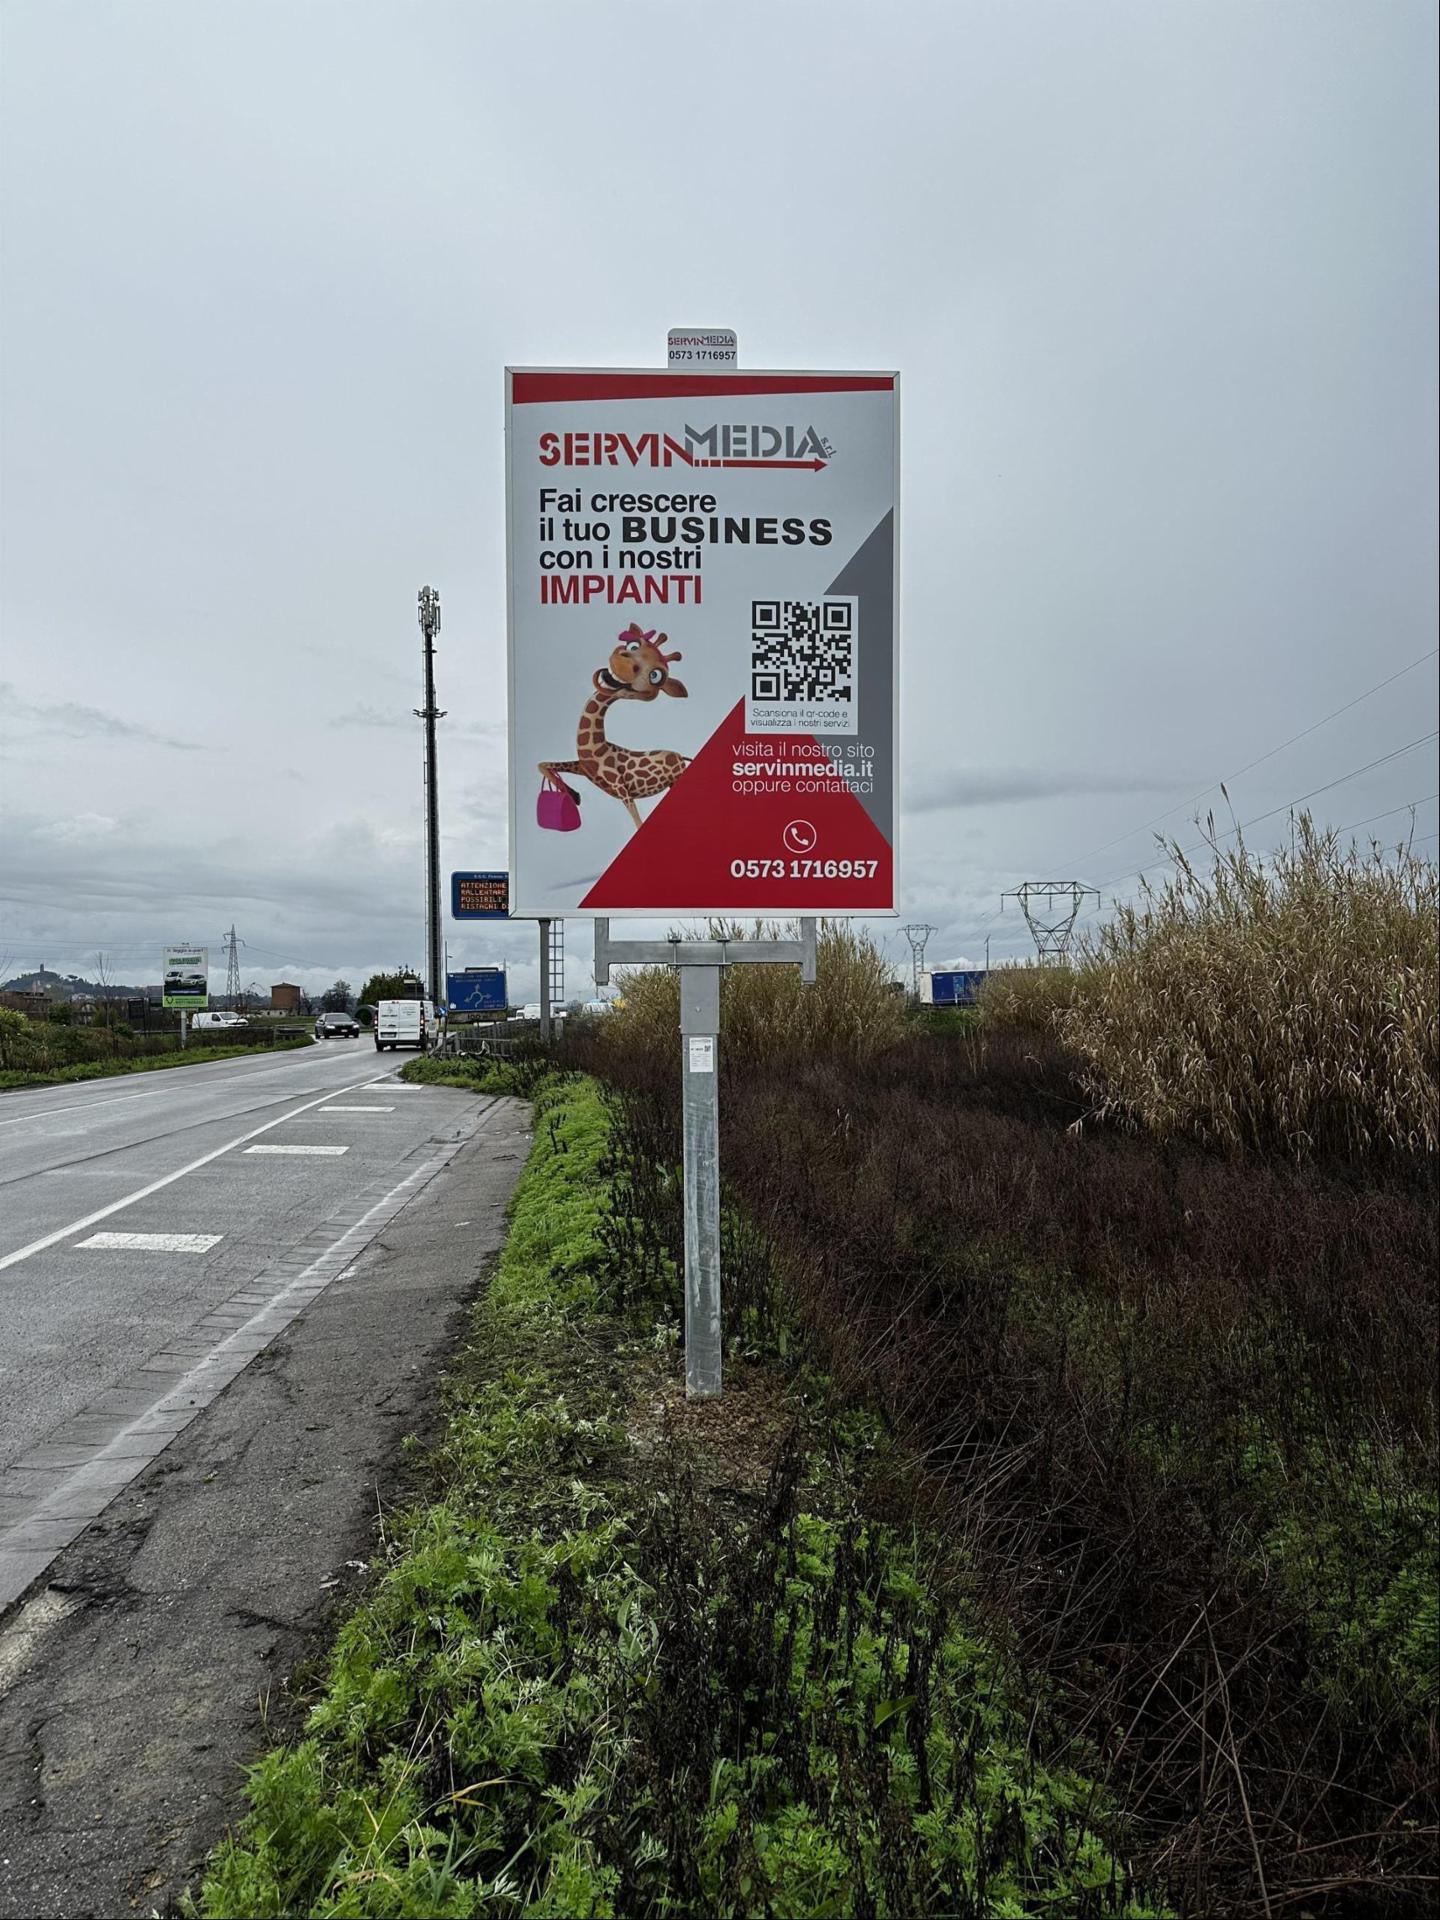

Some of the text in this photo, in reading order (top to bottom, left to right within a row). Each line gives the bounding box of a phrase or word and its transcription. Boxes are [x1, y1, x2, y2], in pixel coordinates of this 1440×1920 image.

[668, 335, 735, 346] SERVINMEDIA
[669, 350, 737, 360] 0573 1716957
[539, 488, 717, 513] Fai crescere
[539, 516, 833, 546] il tuo BUSINESS
[539, 545, 702, 569] con i nostri
[540, 575, 702, 605] IMPIANTI
[752, 708, 798, 718] Scansiona
[800, 708, 804, 718] il
[806, 709, 840, 720] qr-code
[750, 718, 792, 727] visualizza
[798, 719, 822, 727] nostri
[823, 719, 849, 728] servizi
[732, 742, 875, 758] visita il nostro sito
[732, 759, 873, 777] servinmedia.it
[732, 779, 873, 795] oppure contattaci
[730, 859, 879, 879] 0573 1716957
